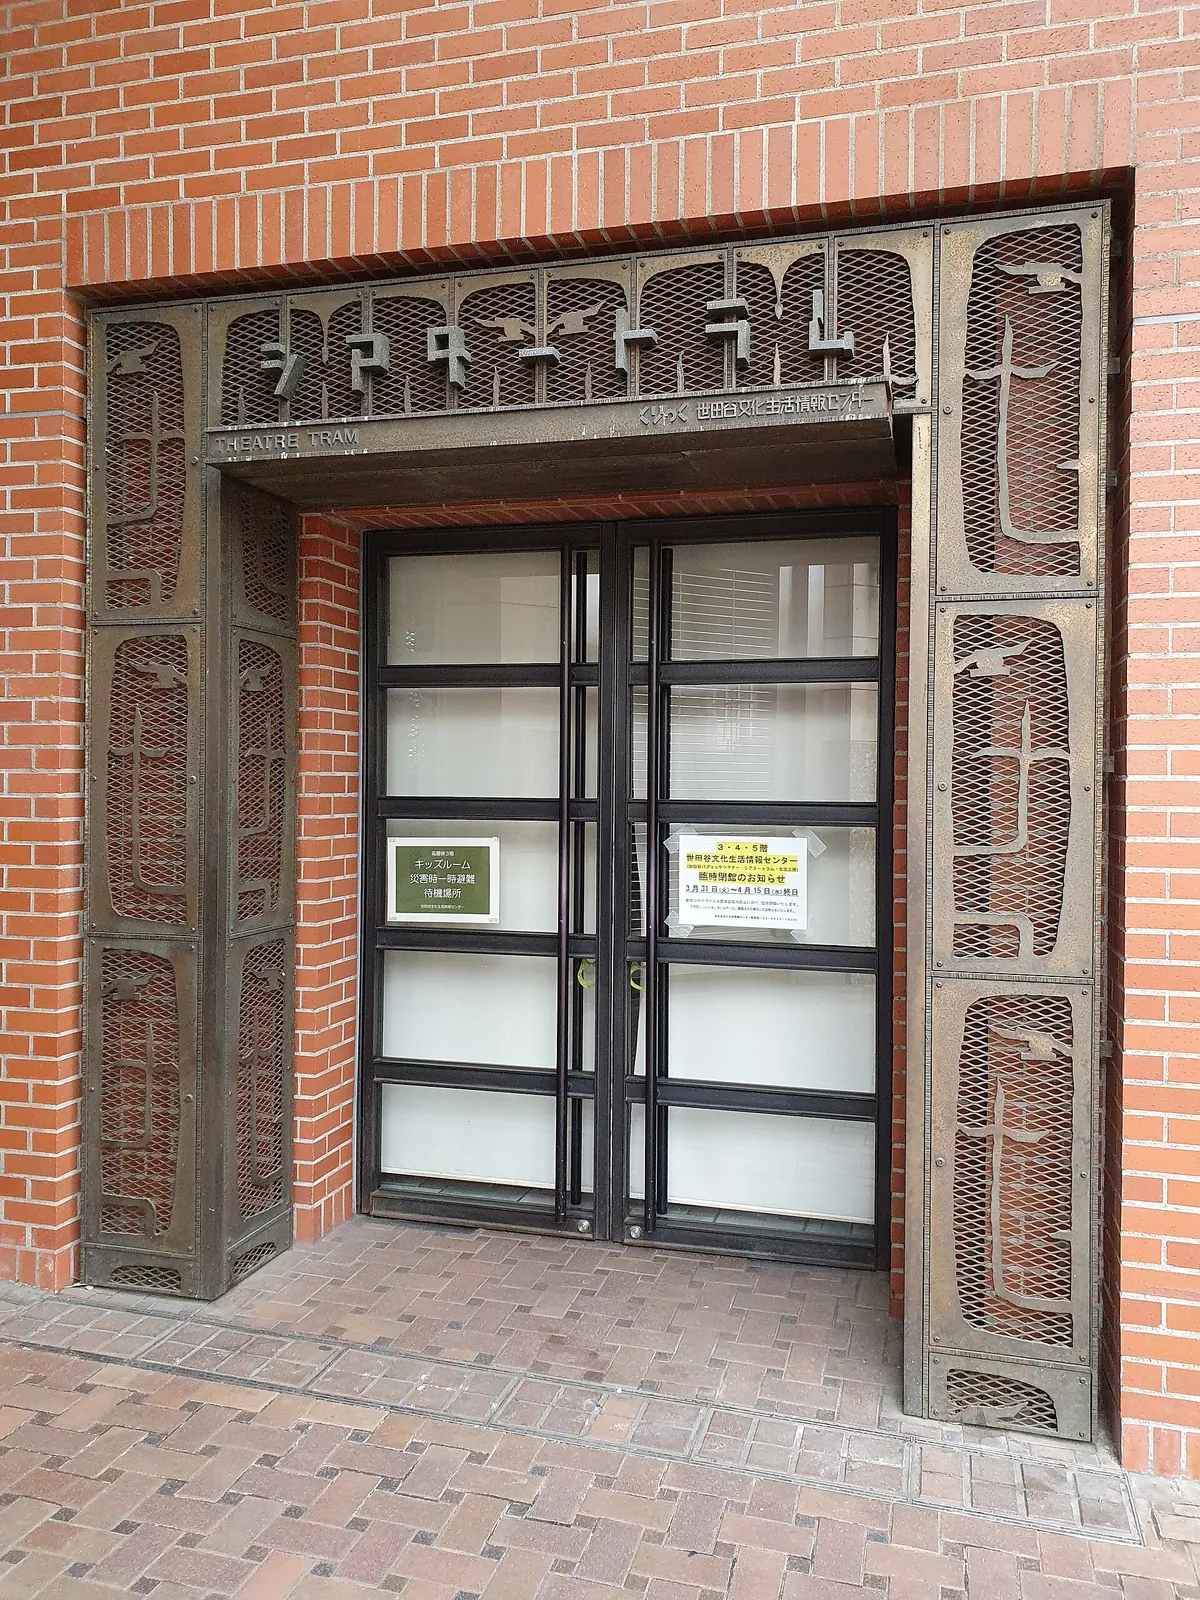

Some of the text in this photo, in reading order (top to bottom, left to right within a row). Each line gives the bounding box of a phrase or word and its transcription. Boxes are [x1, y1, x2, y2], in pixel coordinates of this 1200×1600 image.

[696, 391, 874, 420] 世田谷文化生活情報センター
[215, 427, 361, 454] THEATRE TRAM
[414, 859, 471, 870] キッズルーム
[686, 854, 798, 865] 世田谷文化生活情報センター
[410, 873, 476, 885] 災害時一時避難
[698, 871, 786, 884] 臨時閉館のお知らせ
[423, 888, 462, 899] 待機場所
